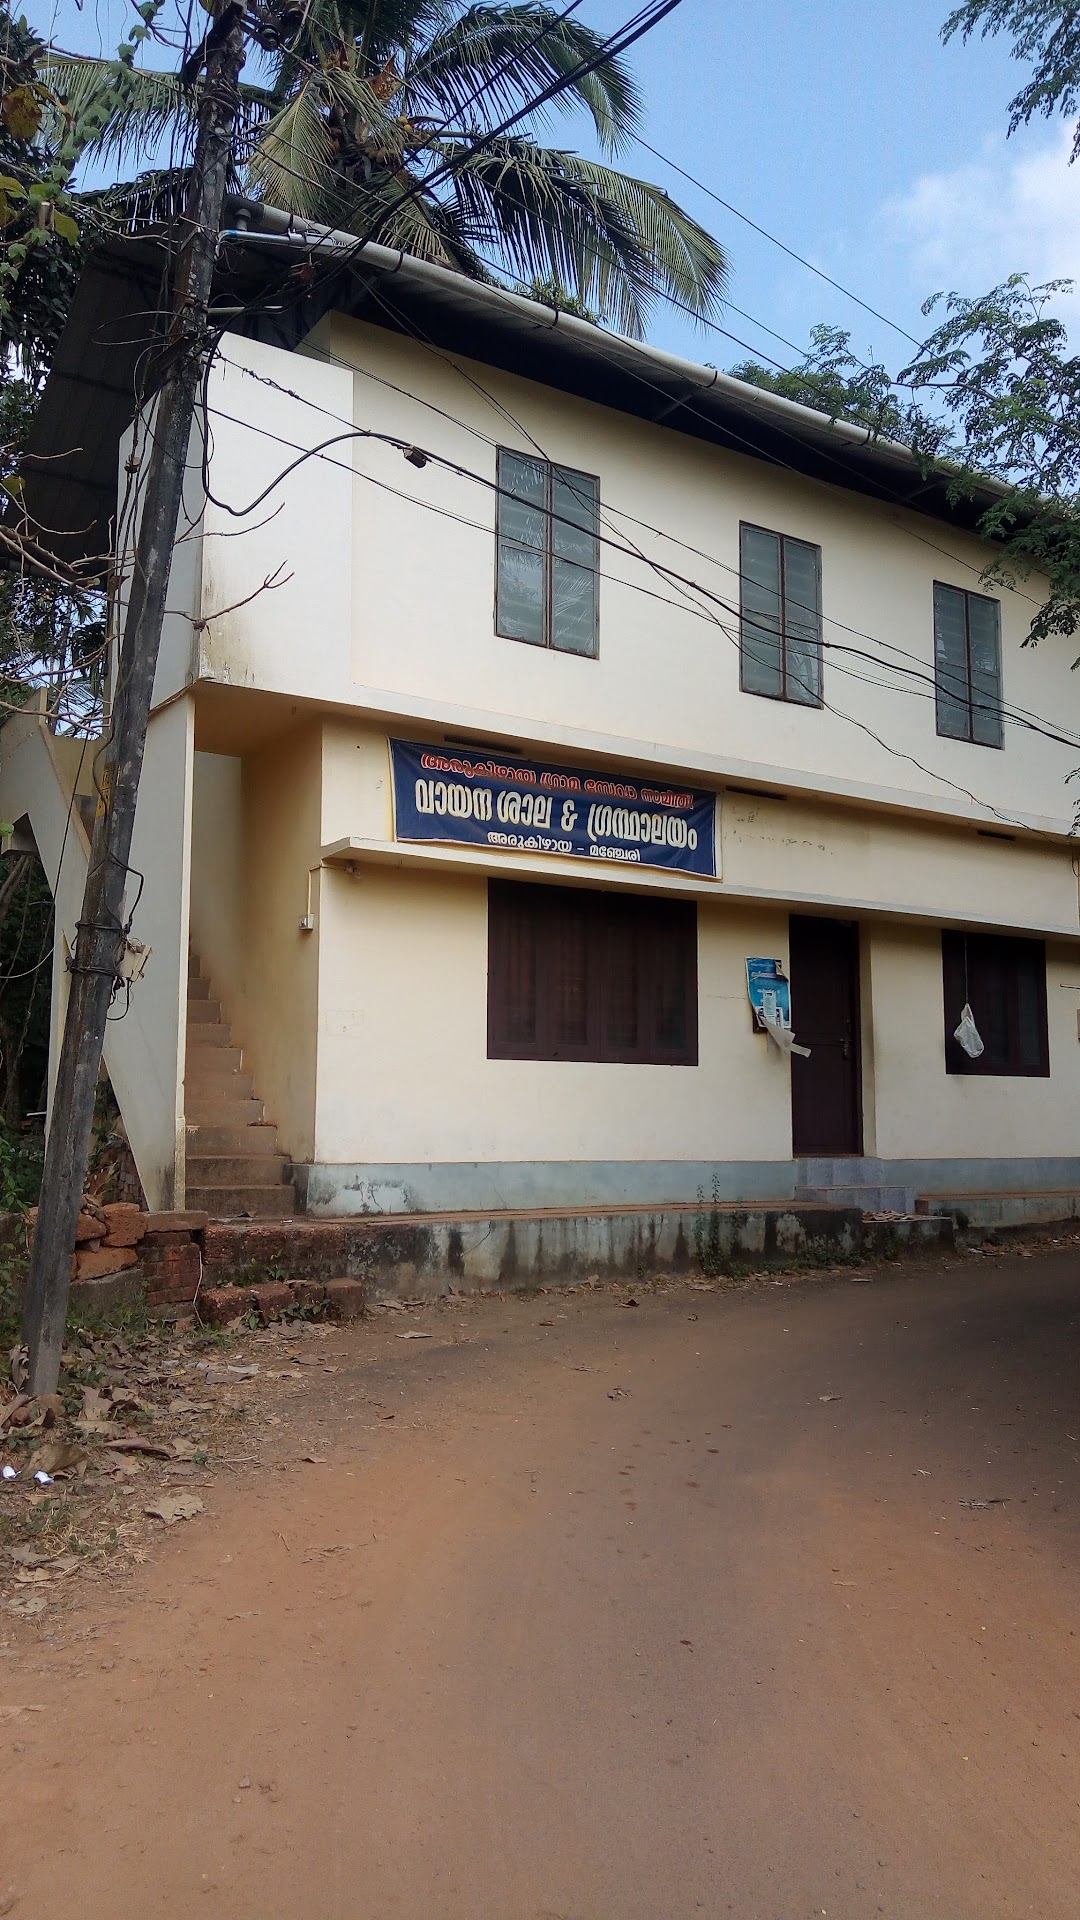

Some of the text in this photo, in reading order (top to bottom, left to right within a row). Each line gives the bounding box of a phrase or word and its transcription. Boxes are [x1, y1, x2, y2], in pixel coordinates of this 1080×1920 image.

[540, 772, 581, 792] ഗ്രാമ
[584, 778, 638, 801] സേവാ
[415, 778, 698, 850] വായന ശാല & ഗ്രന്ഥാലയം
[487, 831, 573, 853] അരുകിഴായ
[589, 844, 641, 862] മഞ്ചേരി
